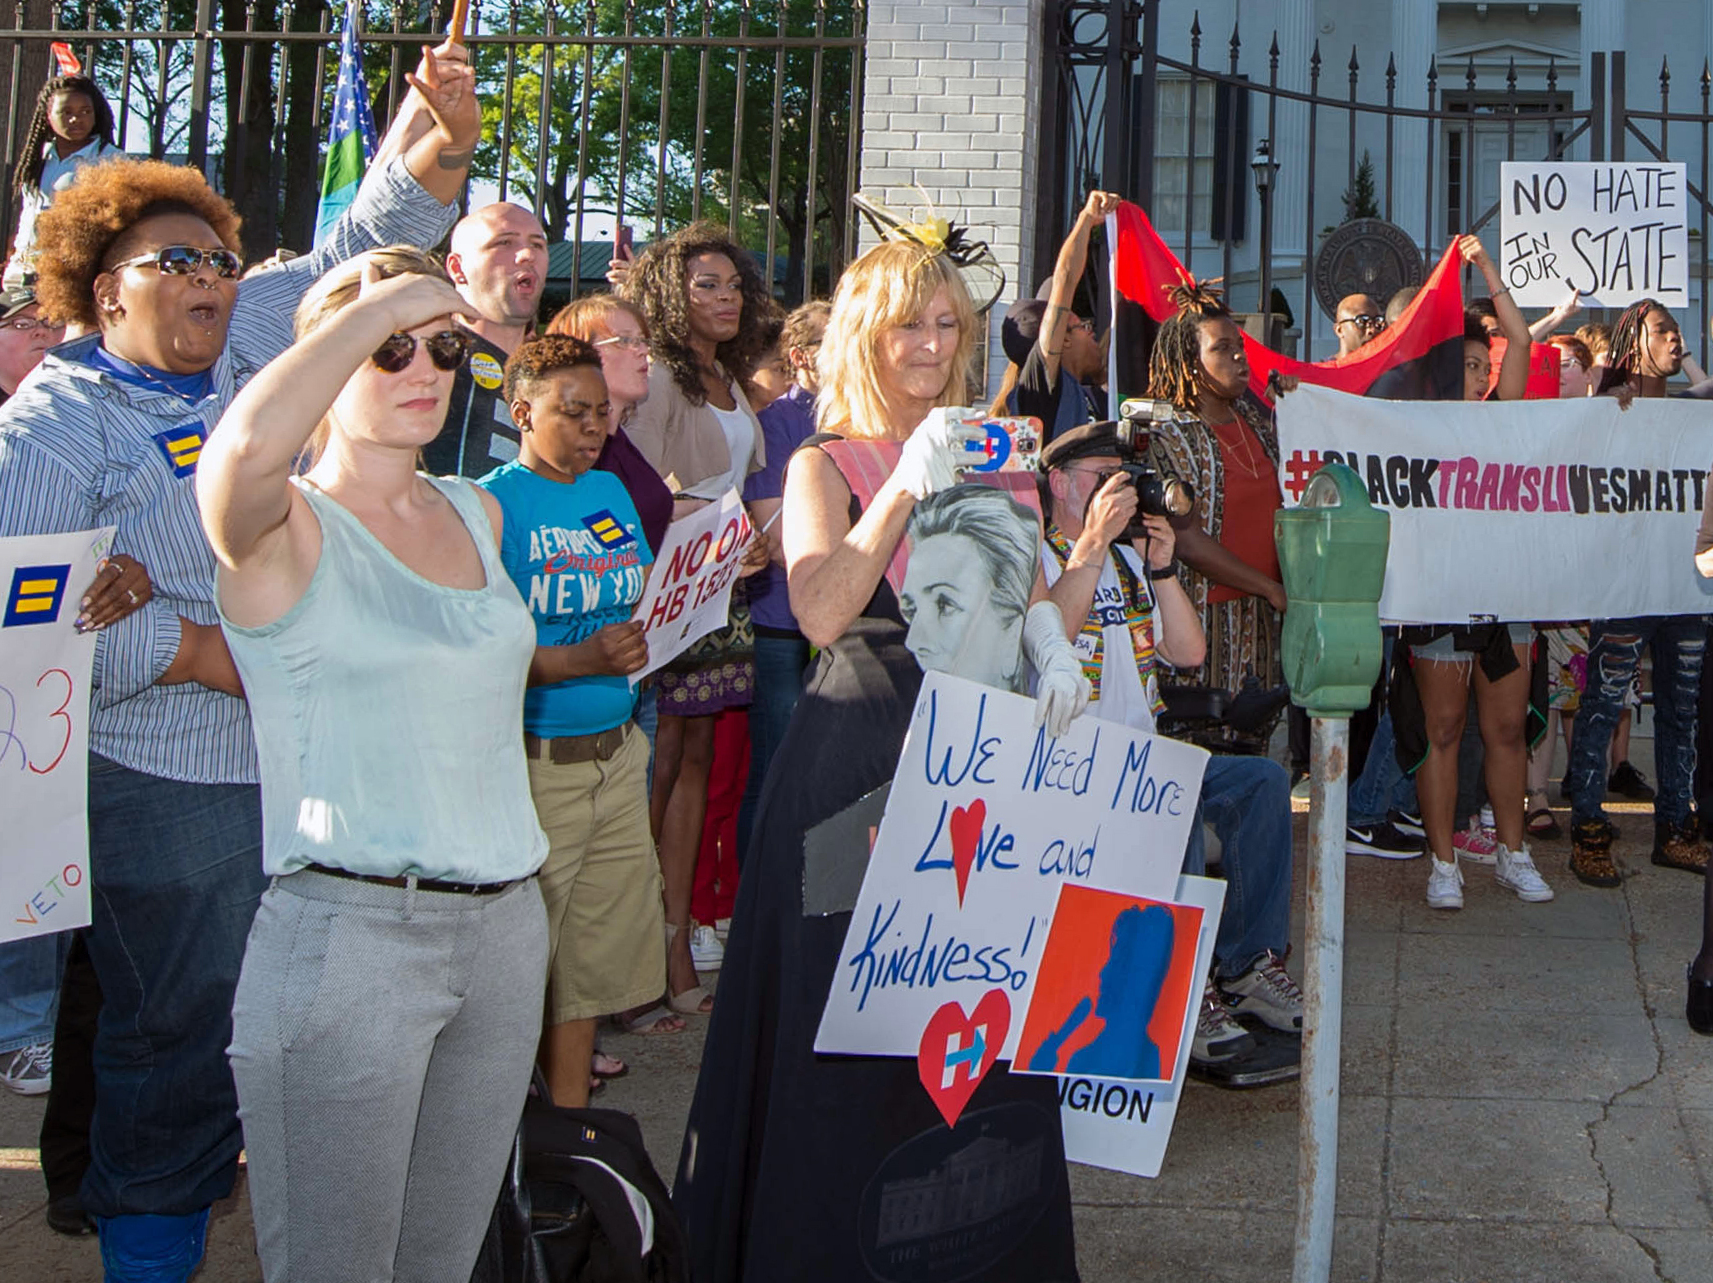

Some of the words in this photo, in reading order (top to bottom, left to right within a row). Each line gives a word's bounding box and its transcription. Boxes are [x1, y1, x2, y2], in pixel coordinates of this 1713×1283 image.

[1513, 172, 1567, 215] NO
[1594, 168, 1676, 214] HATE
[1504, 232, 1550, 265] IN
[1510, 253, 1560, 289] OUR
[1565, 222, 1683, 296] STATE
[661, 530, 713, 589] NO
[716, 513, 752, 564] ON
[529, 573, 601, 615] NEW
[645, 583, 689, 632] HB
[16, 864, 82, 926] VETO
